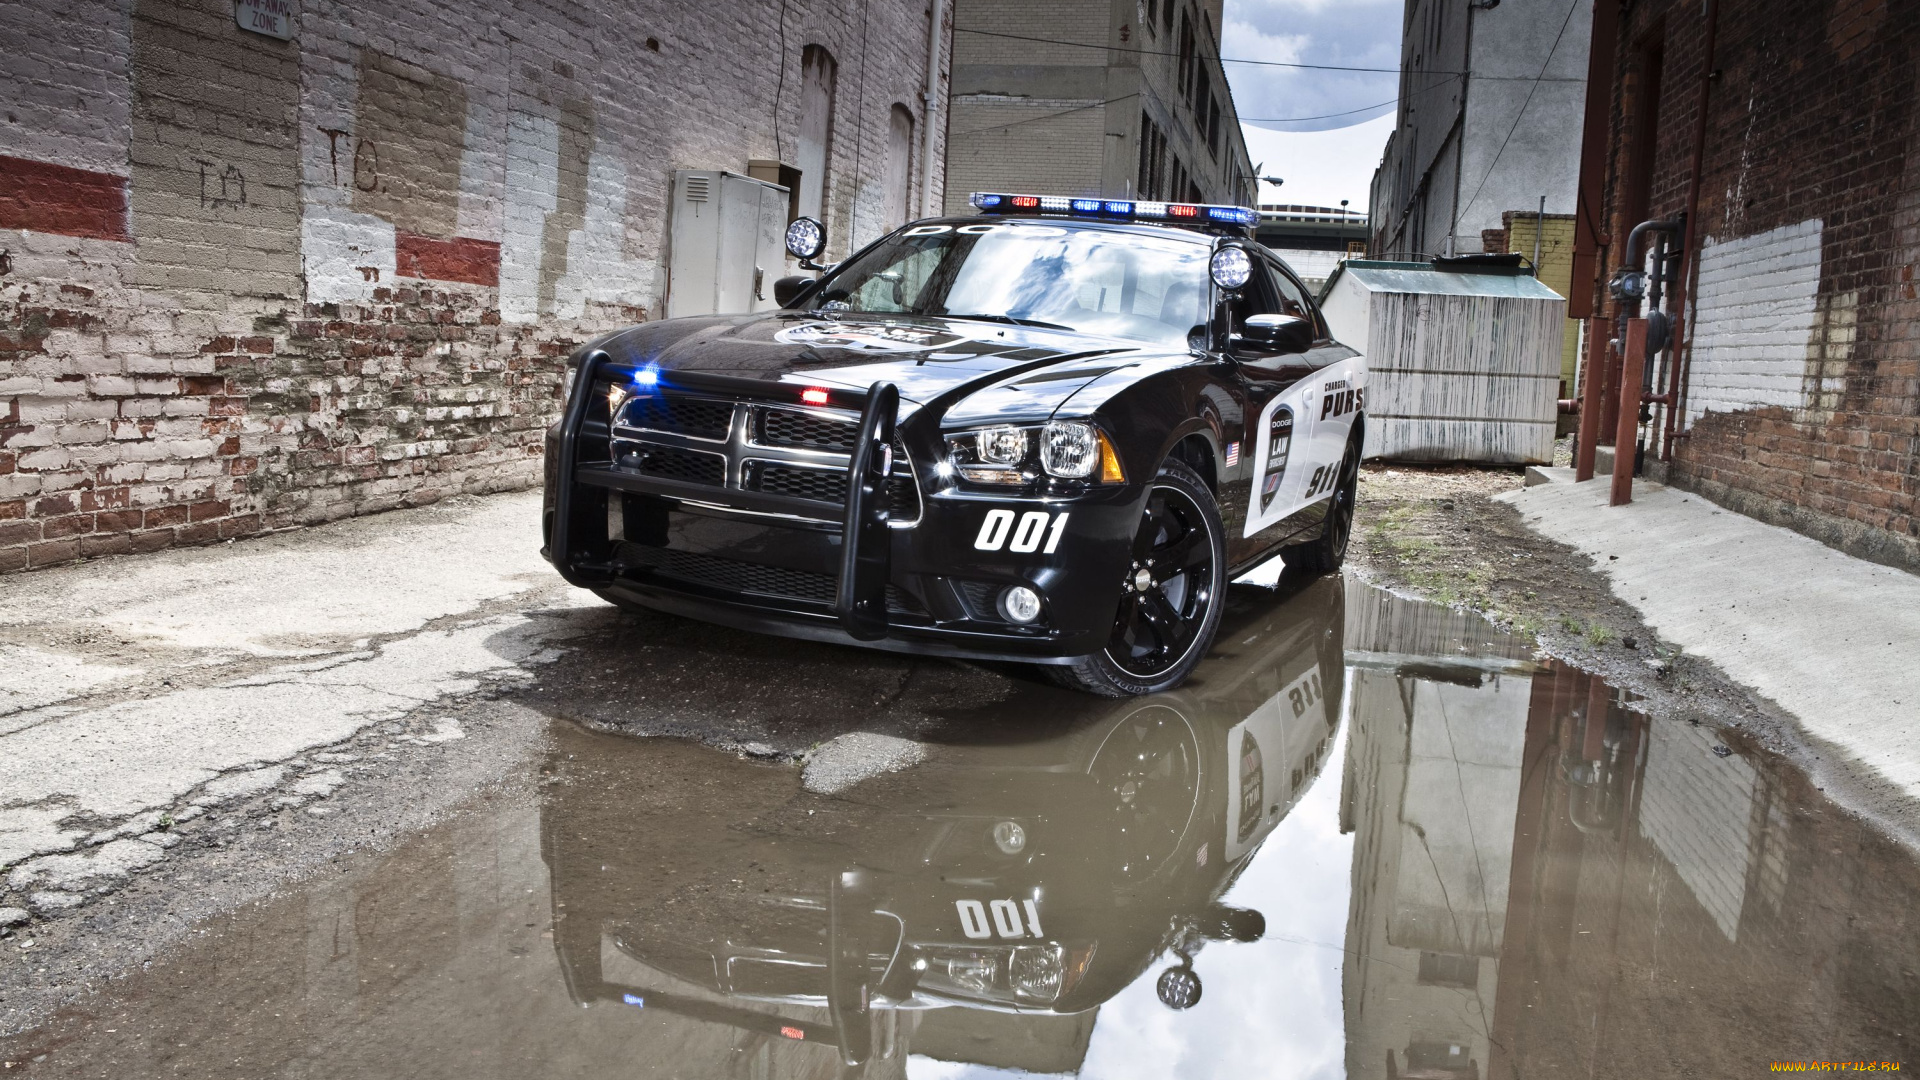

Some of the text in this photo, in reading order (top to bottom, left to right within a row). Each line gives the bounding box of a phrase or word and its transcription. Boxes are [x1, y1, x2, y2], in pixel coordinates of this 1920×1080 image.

[252, 10, 279, 33] ZONE
[1324, 379, 1346, 393] CHARGER
[1271, 418, 1292, 429] DODGE
[1271, 436, 1289, 456] LAW
[1304, 460, 1341, 499] 911
[973, 508, 1070, 554] 001
